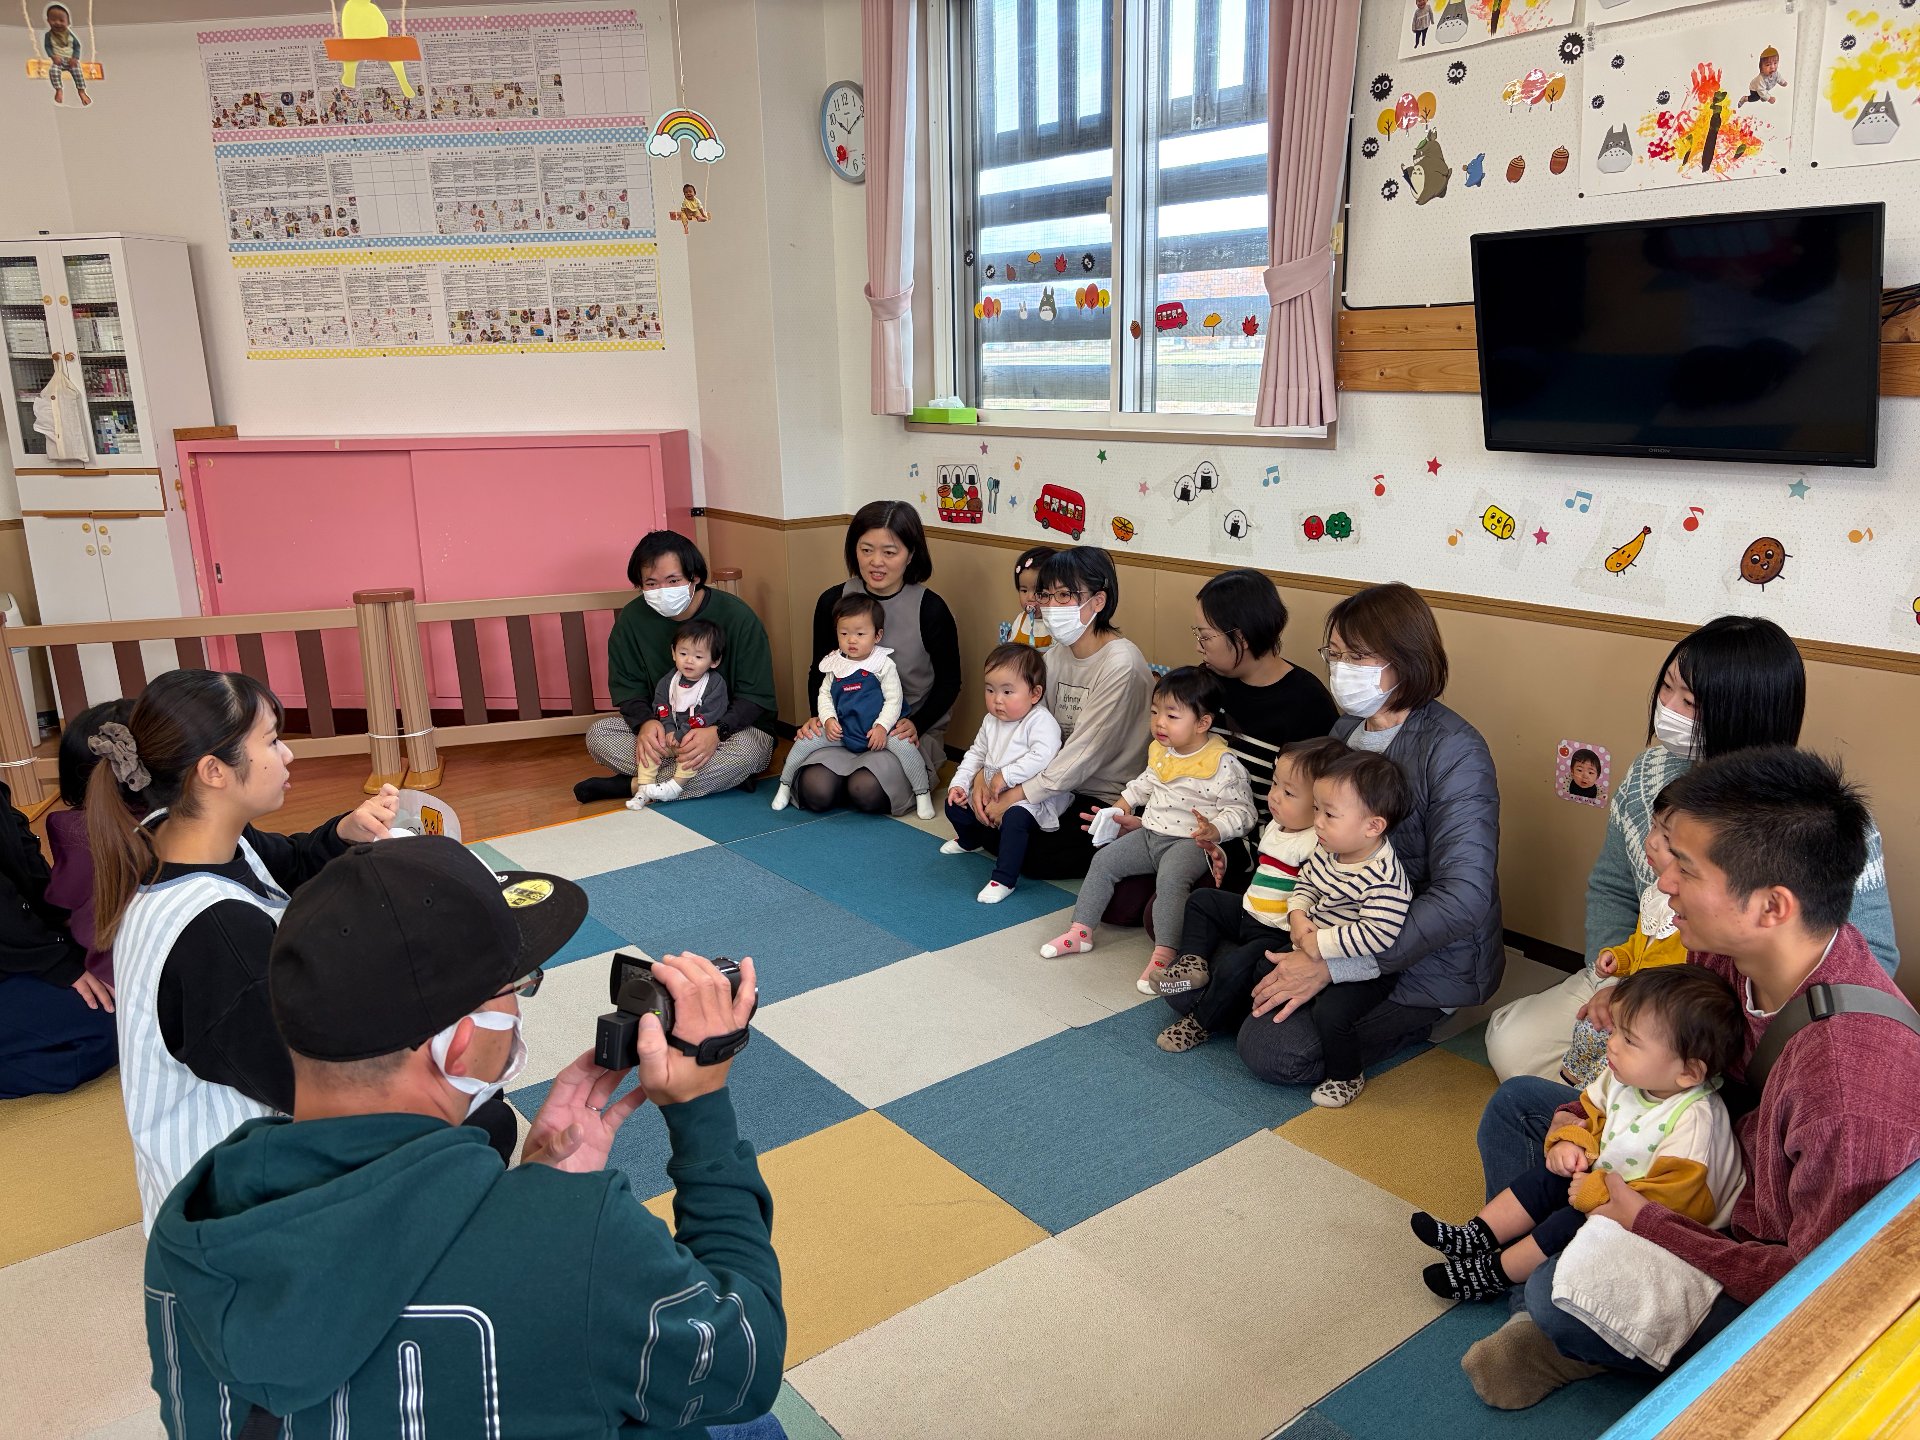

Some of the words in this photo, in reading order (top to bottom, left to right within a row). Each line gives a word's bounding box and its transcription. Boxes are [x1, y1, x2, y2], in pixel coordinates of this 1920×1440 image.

[833, 98, 841, 112] 11
[841, 92, 849, 106] 12
[851, 95, 856, 108] 1
[829, 112, 837, 126] 10
[830, 130, 836, 142] 9
[852, 158, 859, 172] 6
